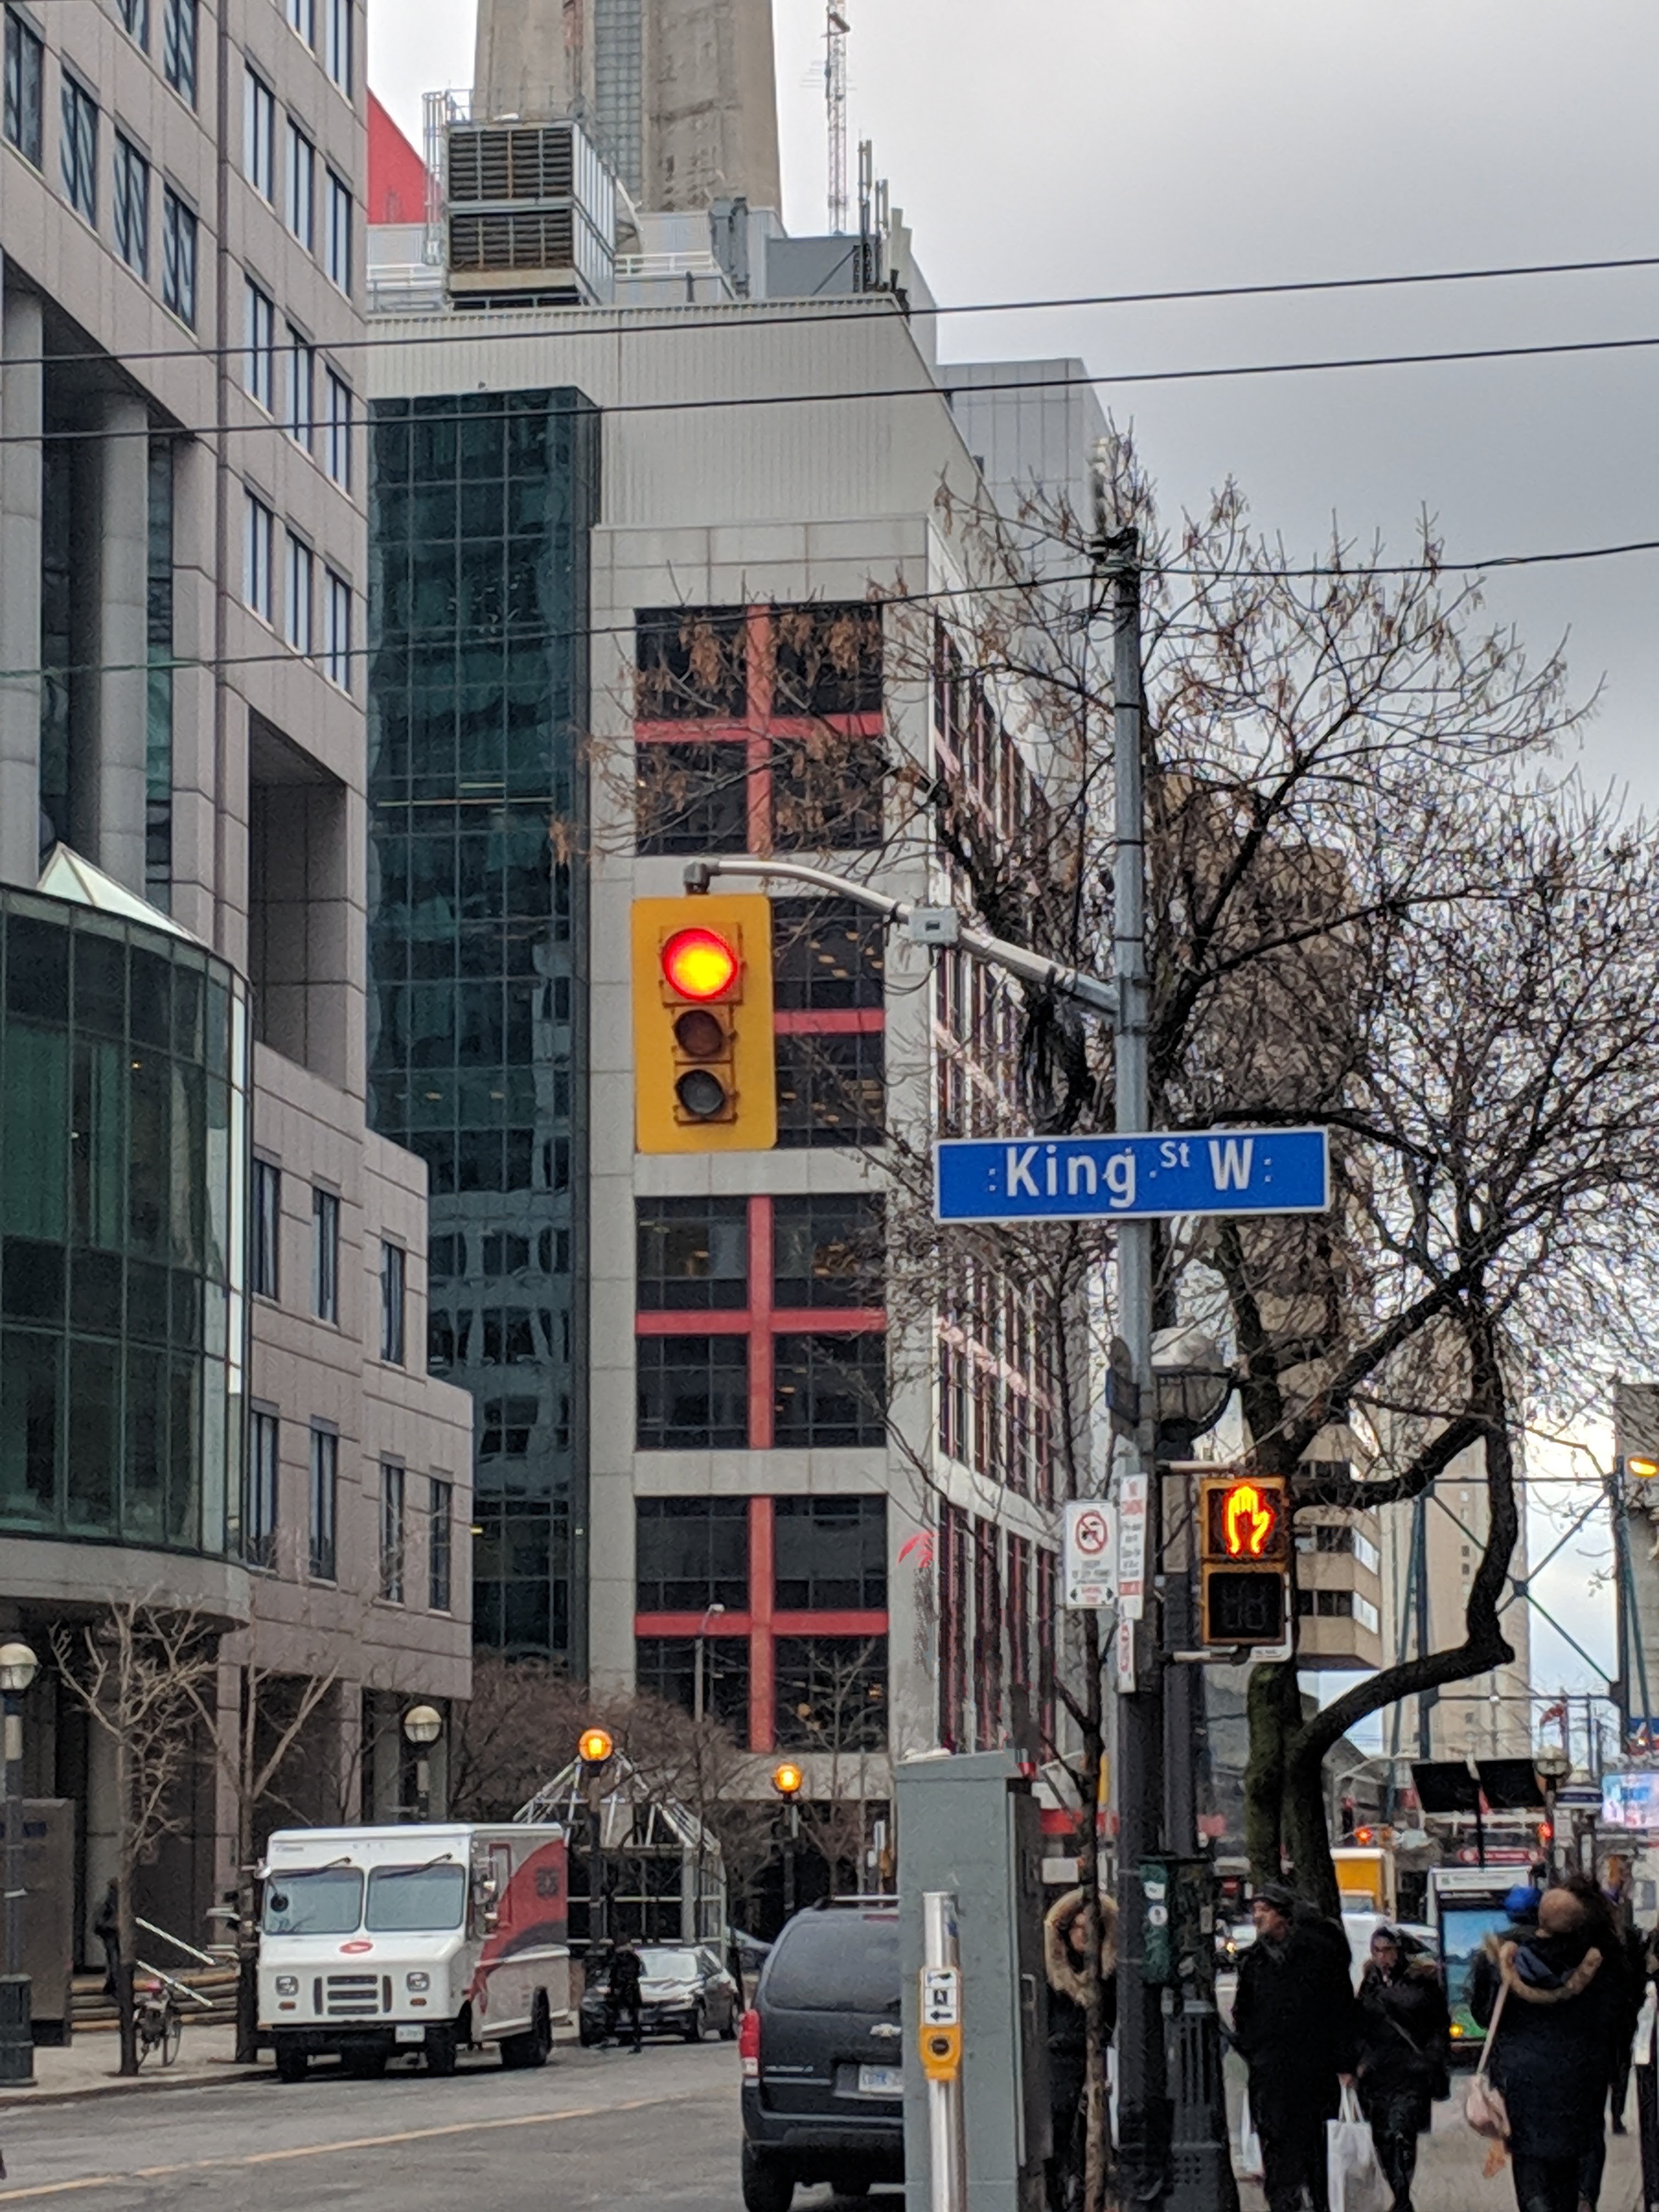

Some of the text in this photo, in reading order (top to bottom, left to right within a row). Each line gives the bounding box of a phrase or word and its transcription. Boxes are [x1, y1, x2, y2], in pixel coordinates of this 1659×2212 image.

[1006, 1138, 1254, 1208] King St W
